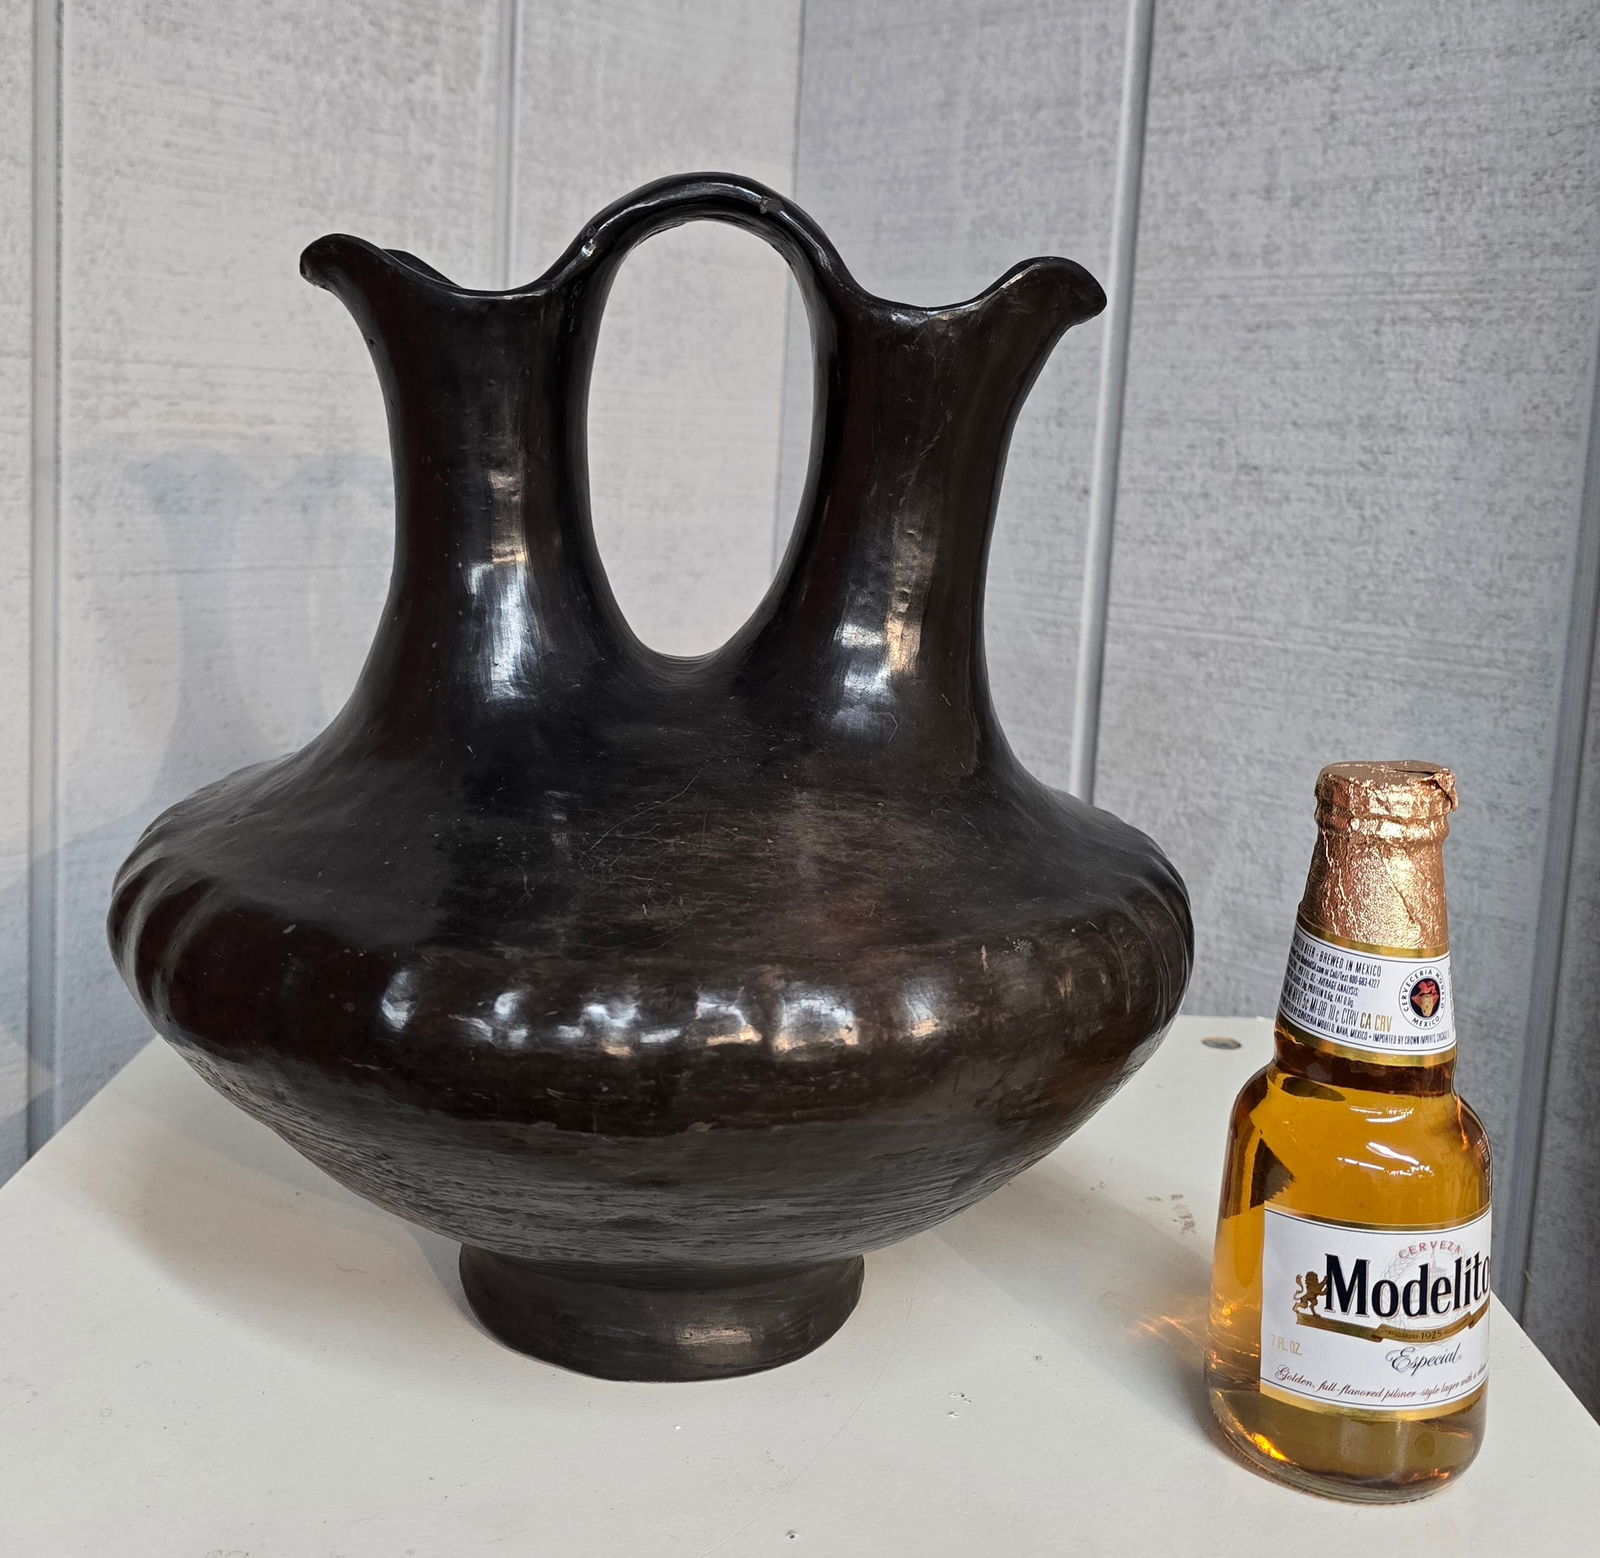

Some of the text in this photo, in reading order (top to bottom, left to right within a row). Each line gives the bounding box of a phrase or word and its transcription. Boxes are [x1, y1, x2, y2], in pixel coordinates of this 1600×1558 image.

[1319, 950, 1344, 969] BREWED
[1345, 959, 1353, 971] IN
[1355, 960, 1381, 977] MEXICO
[1318, 976, 1337, 990] AVERAGE
[1359, 1011, 1371, 1029] CA
[1374, 1013, 1392, 1032] CRV
[1412, 1015, 1440, 1027] MEXICO
[1349, 1028, 1367, 1040] MEXICO
[1398, 1240, 1462, 1259] CERVEZA
[1323, 1251, 1490, 1318] Modelito
[1385, 1342, 1461, 1377] Especial
[1275, 1364, 1316, 1390] Golden,
[1441, 1382, 1460, 1395] lager
